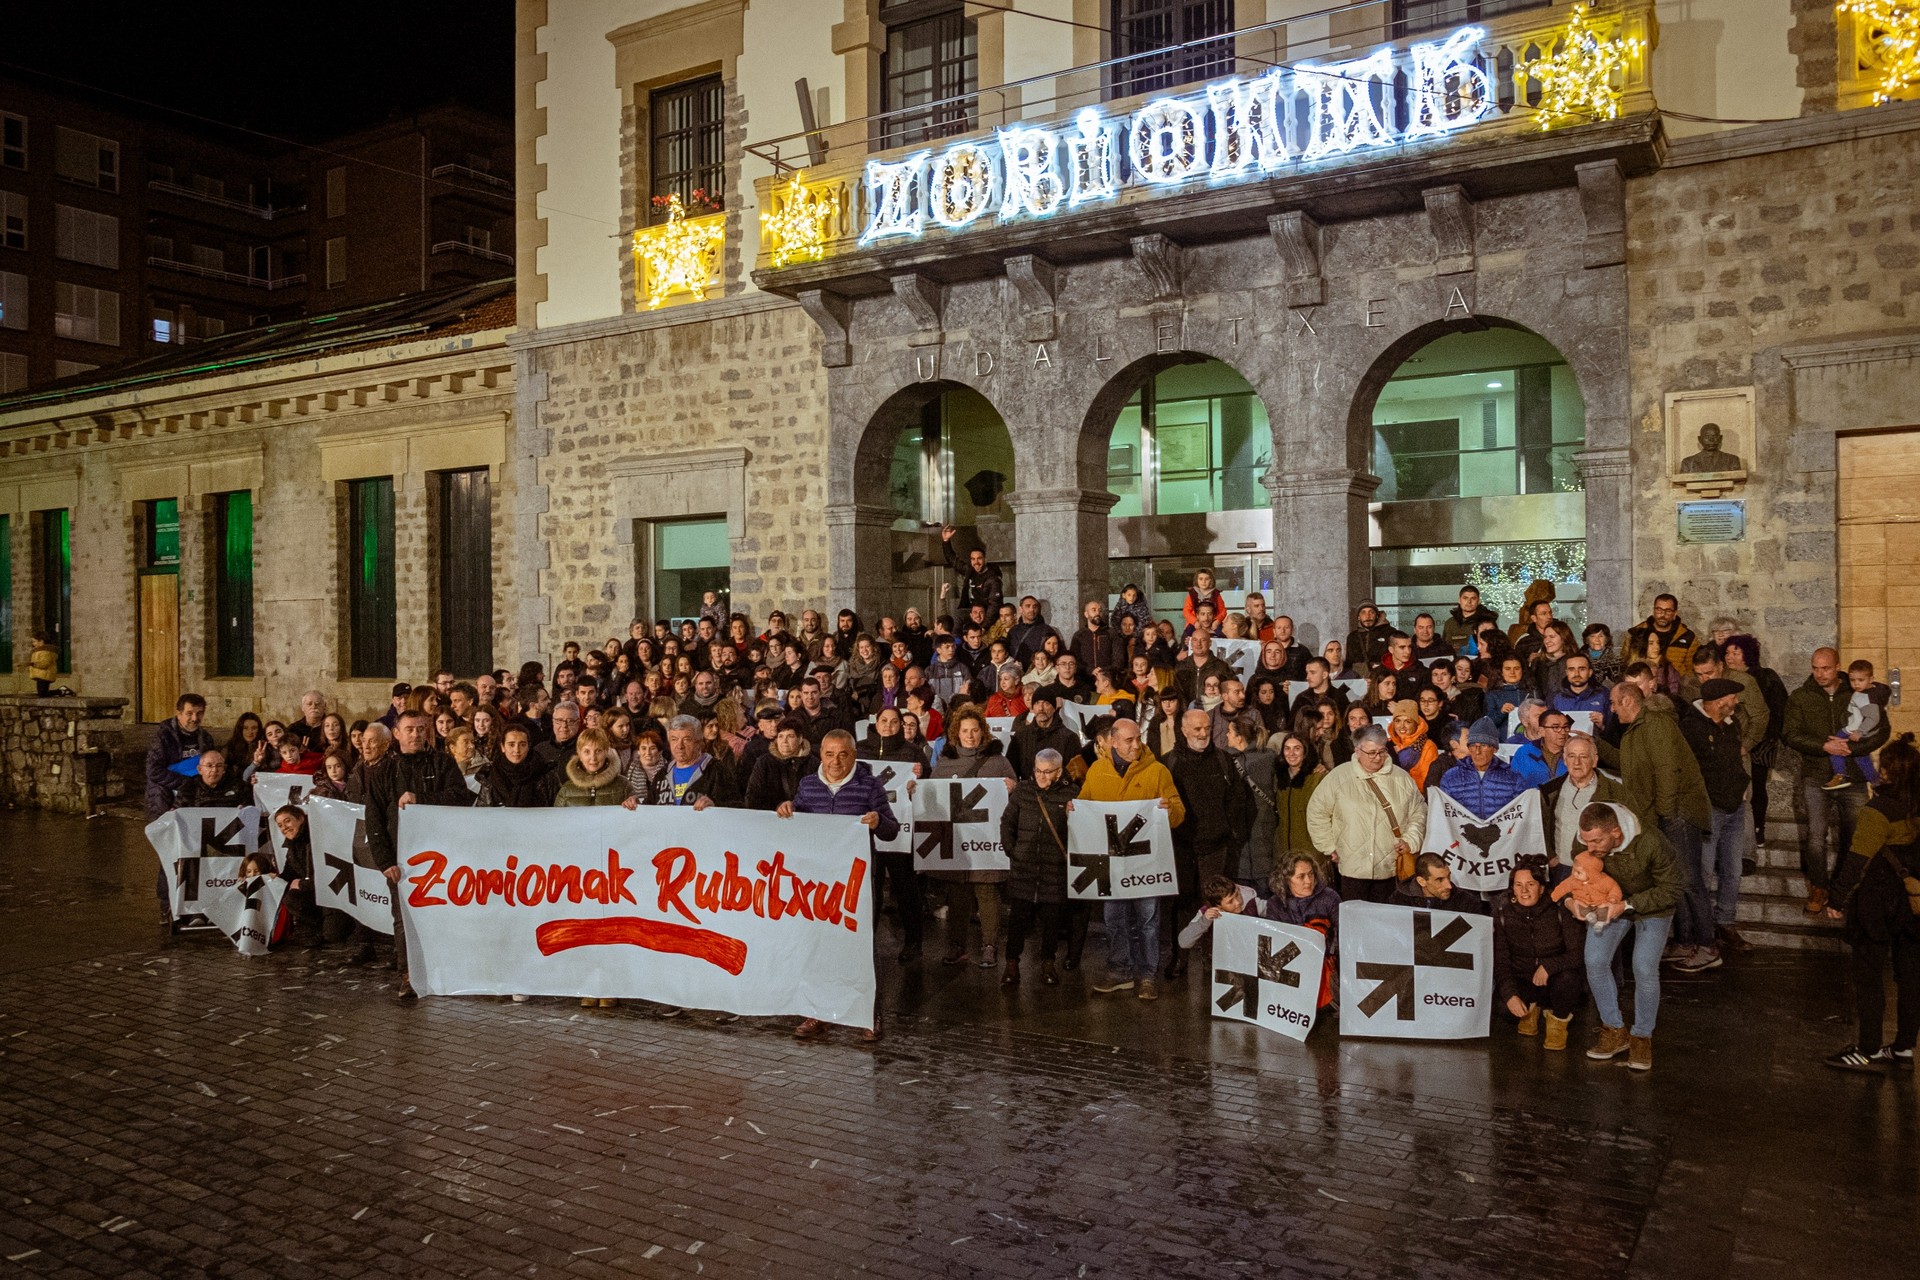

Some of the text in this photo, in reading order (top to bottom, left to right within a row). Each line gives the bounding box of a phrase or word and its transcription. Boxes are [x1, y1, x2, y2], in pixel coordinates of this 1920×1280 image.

[916, 286, 1473, 382] UDALETXEA
[961, 839, 1005, 852] etxera
[205, 877, 238, 888] etxer
[1120, 871, 1173, 888] etxera
[359, 888, 390, 905] etxera
[407, 846, 867, 933] Zorionak Rubitxu!
[241, 925, 267, 945] txera
[1422, 993, 1476, 1009] etxera
[1266, 1002, 1311, 1029] etxera
